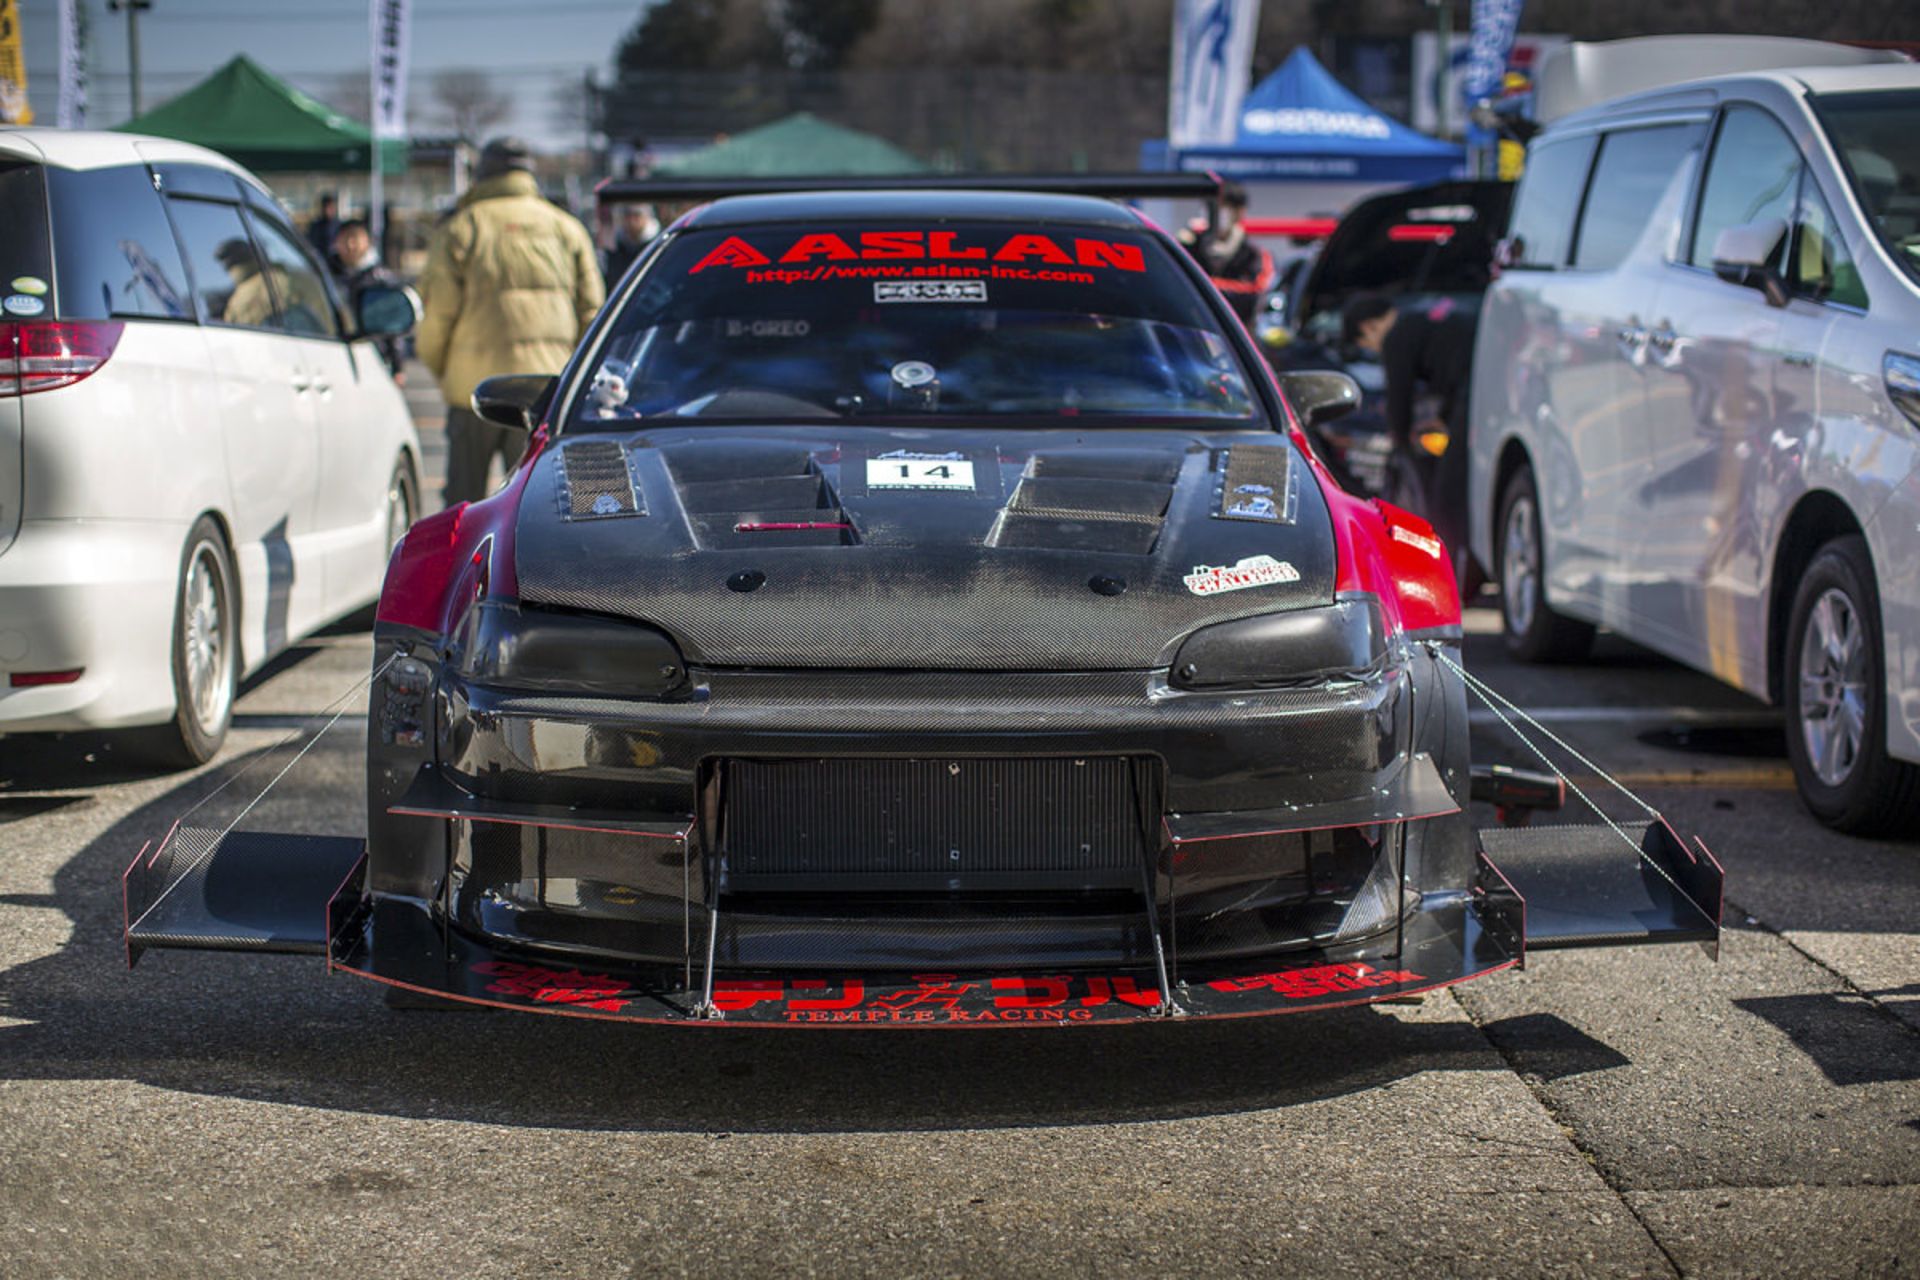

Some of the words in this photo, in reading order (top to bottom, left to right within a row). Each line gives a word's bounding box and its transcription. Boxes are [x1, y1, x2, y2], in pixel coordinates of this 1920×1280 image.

[746, 264, 1095, 285] http://www.aslan-inc.com
[895, 464, 955, 479] 14
[782, 1010, 936, 1023] TEMPLE
[949, 1008, 1094, 1023] RACING
